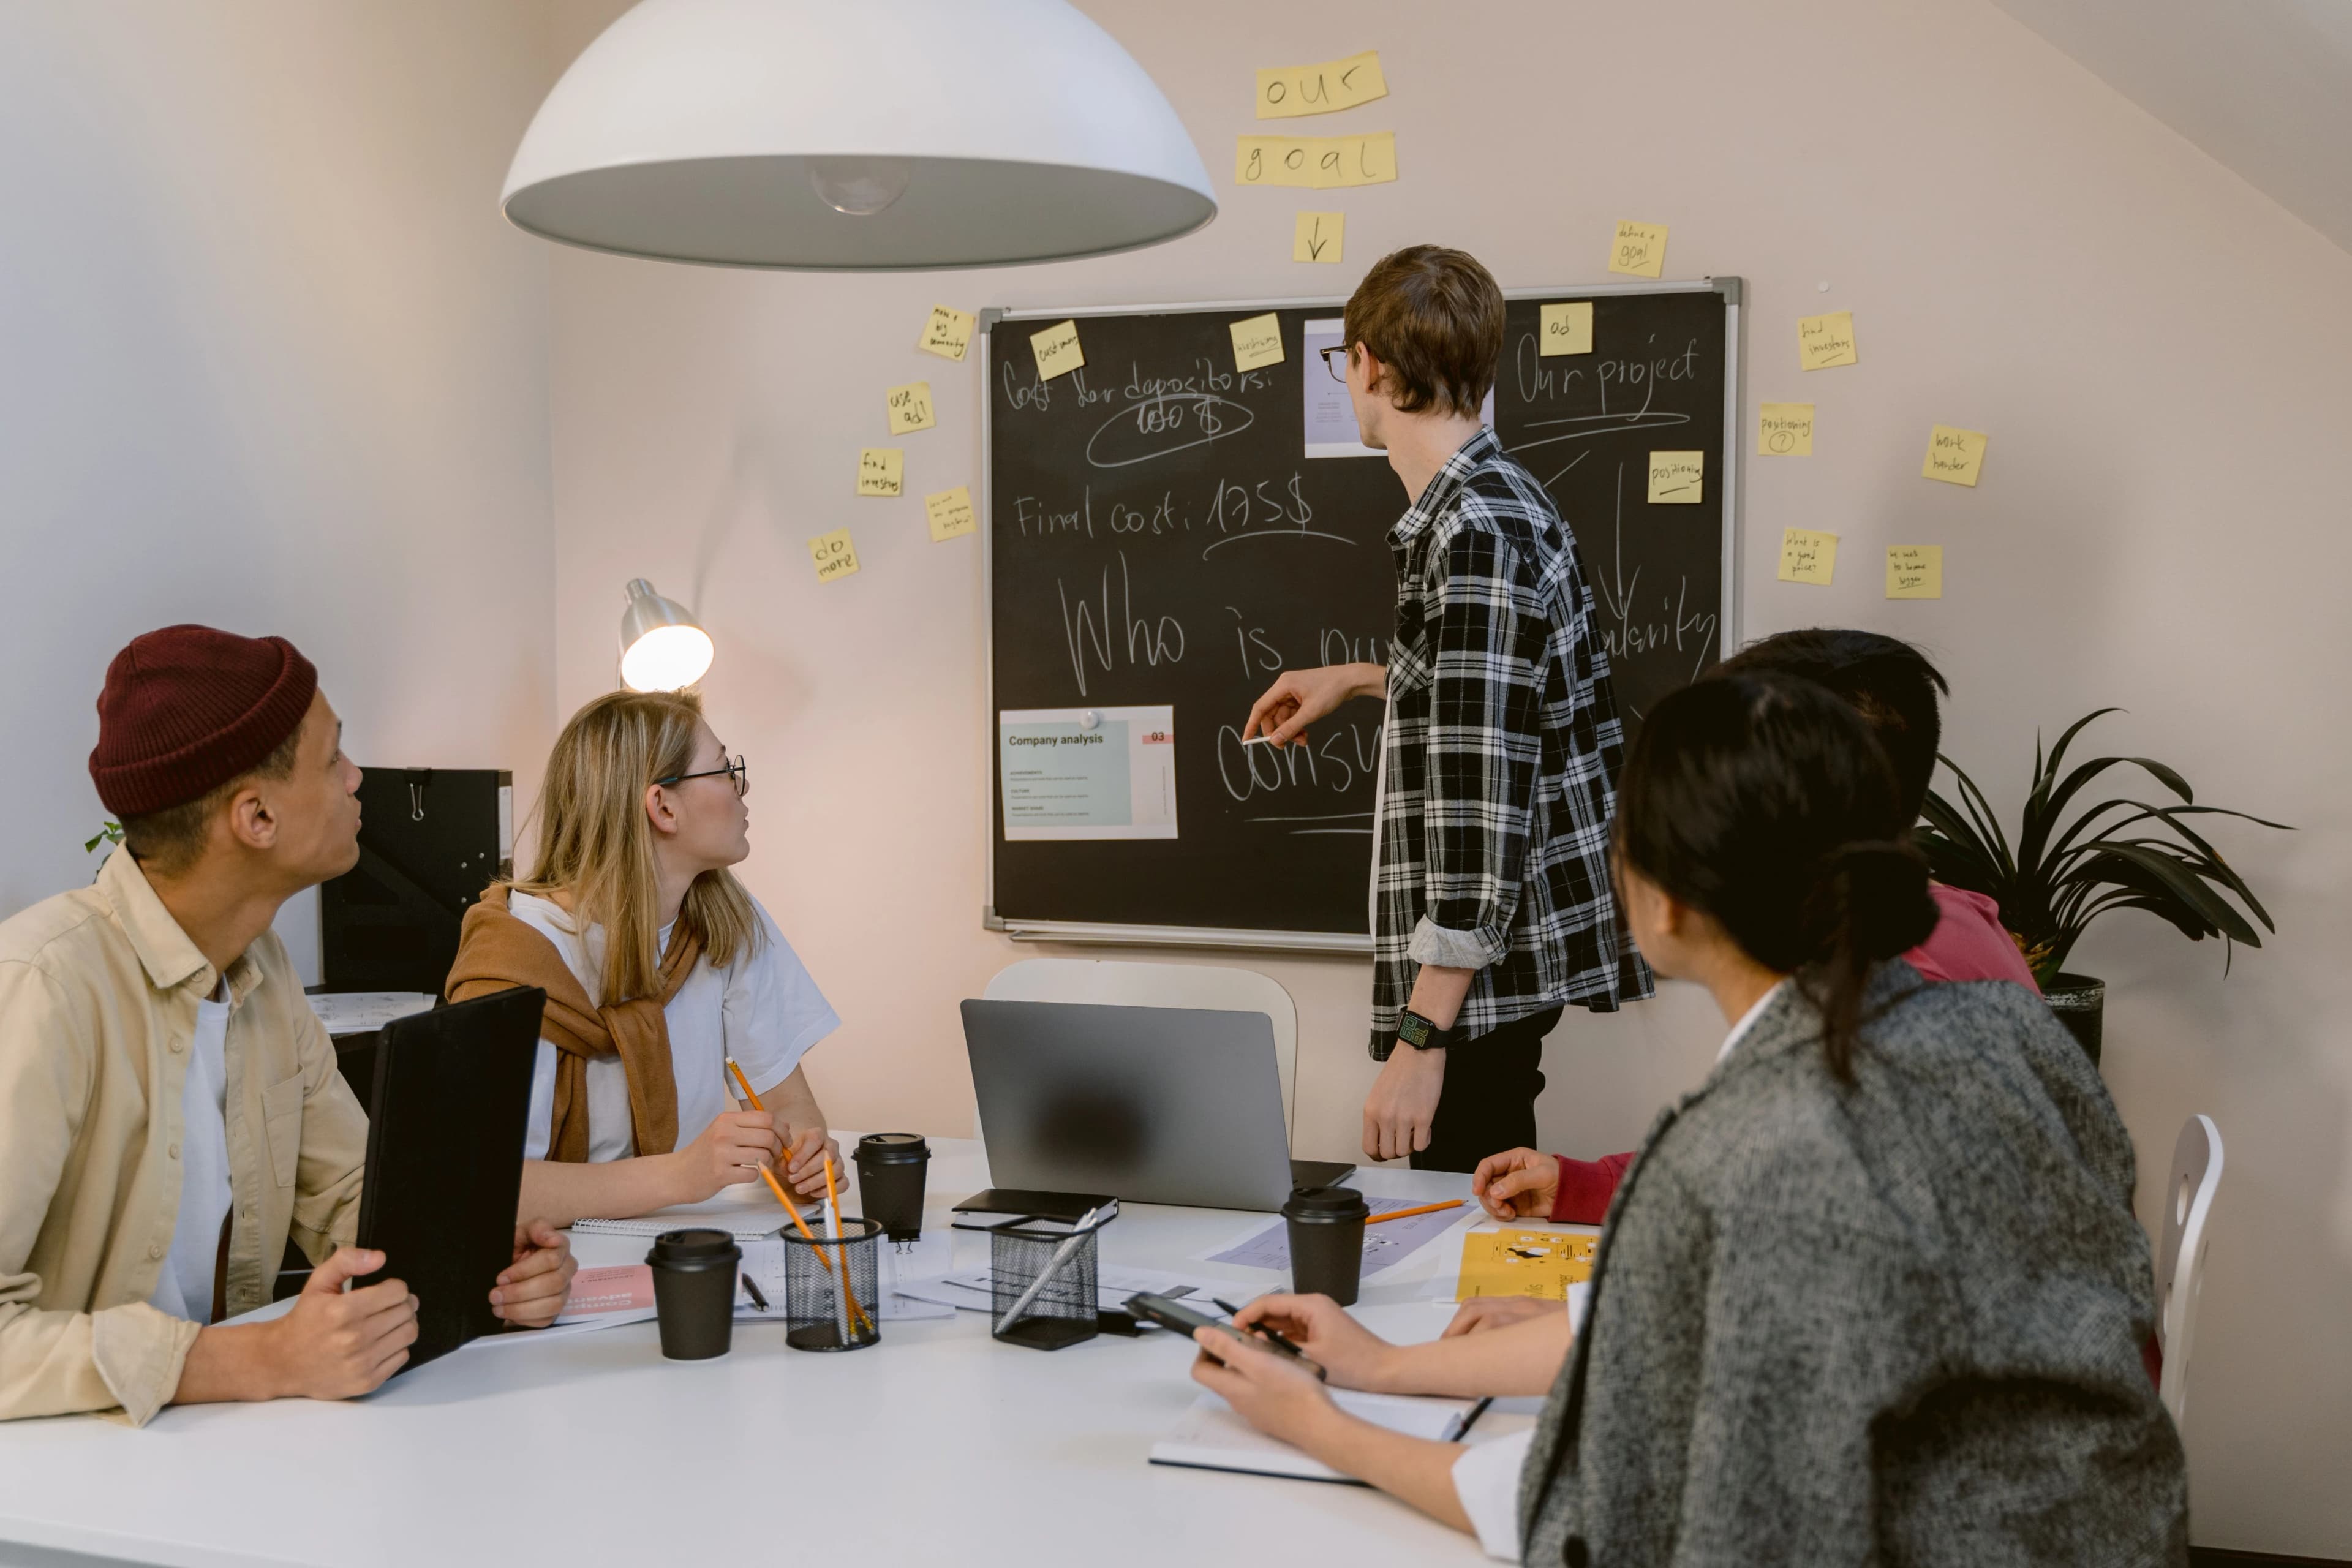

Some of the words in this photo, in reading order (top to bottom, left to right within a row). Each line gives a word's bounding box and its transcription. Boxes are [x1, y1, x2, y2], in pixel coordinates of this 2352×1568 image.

[1266, 65, 1361, 104] our
[1245, 141, 1376, 181] goal
[1618, 243, 1648, 267] goal
[1550, 314, 1570, 336] ad
[1517, 333, 1583, 402] Our
[1596, 333, 1700, 422] project
[890, 390, 911, 408] use
[1014, 485, 1095, 538] Final
[815, 538, 844, 560] do
[818, 553, 854, 577] more
[1058, 550, 1185, 697] Who
[1225, 606, 1283, 680] is
[1009, 736, 1058, 748] Company
[1061, 733, 1104, 746] analysis
[1152, 731, 1164, 742] 03
